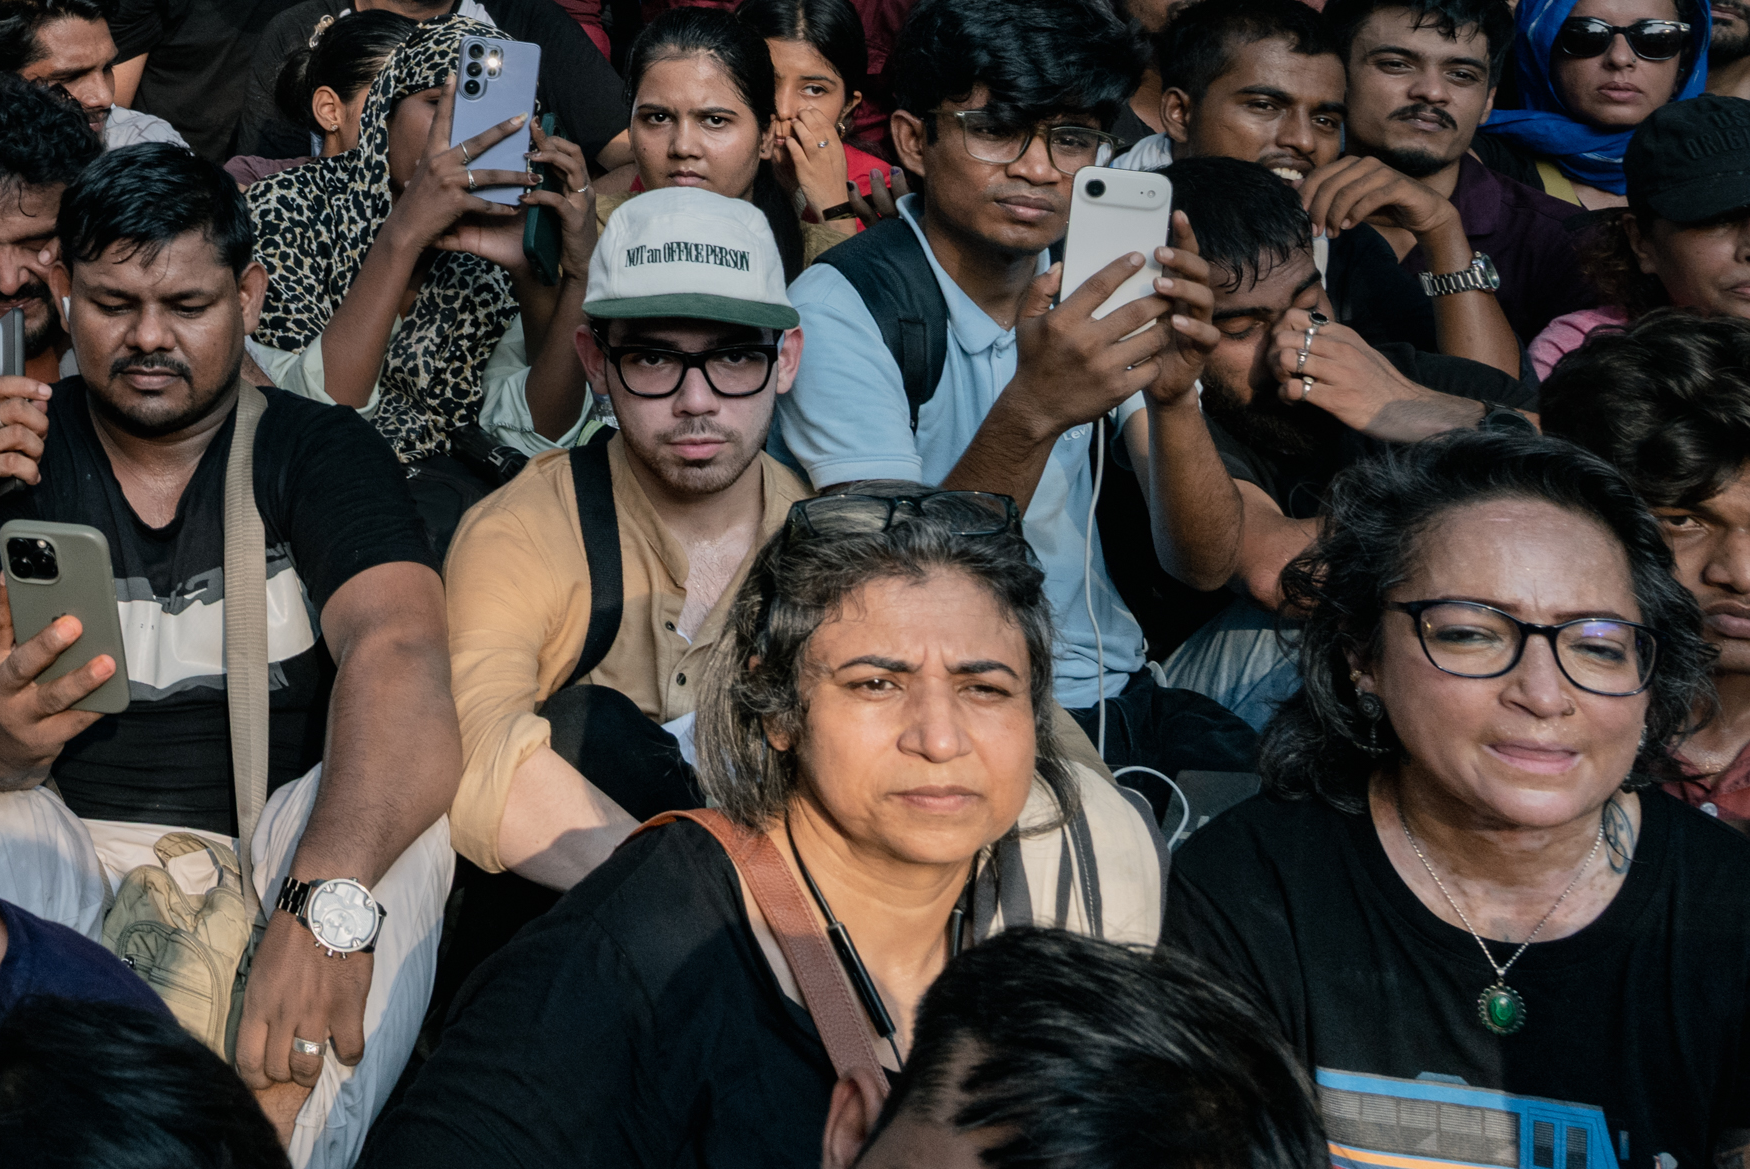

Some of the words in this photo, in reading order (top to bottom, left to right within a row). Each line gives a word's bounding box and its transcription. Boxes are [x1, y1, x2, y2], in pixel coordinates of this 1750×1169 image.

[624, 244, 647, 268] NOT
[647, 248, 662, 264] an
[663, 241, 704, 263] OFFICE
[704, 243, 750, 272] PERSON
